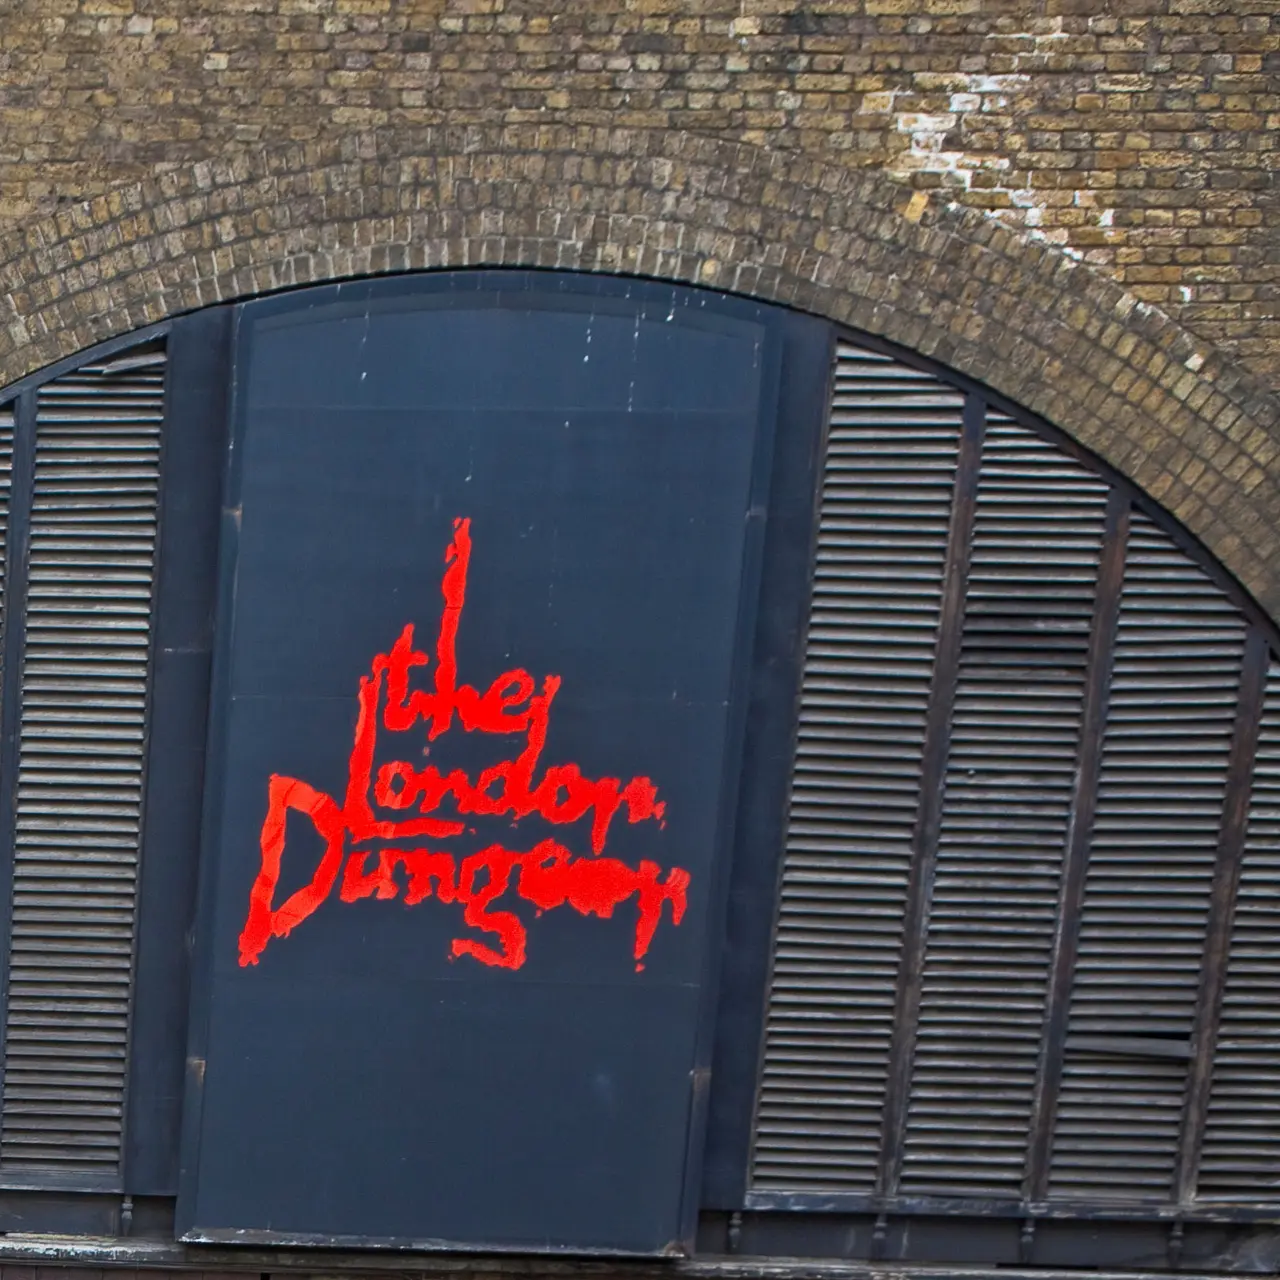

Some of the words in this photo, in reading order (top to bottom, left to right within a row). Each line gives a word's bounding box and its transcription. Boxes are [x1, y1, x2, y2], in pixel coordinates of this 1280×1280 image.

[373, 516, 536, 741] the
[343, 674, 667, 856] London
[237, 772, 692, 972] Dungeon
